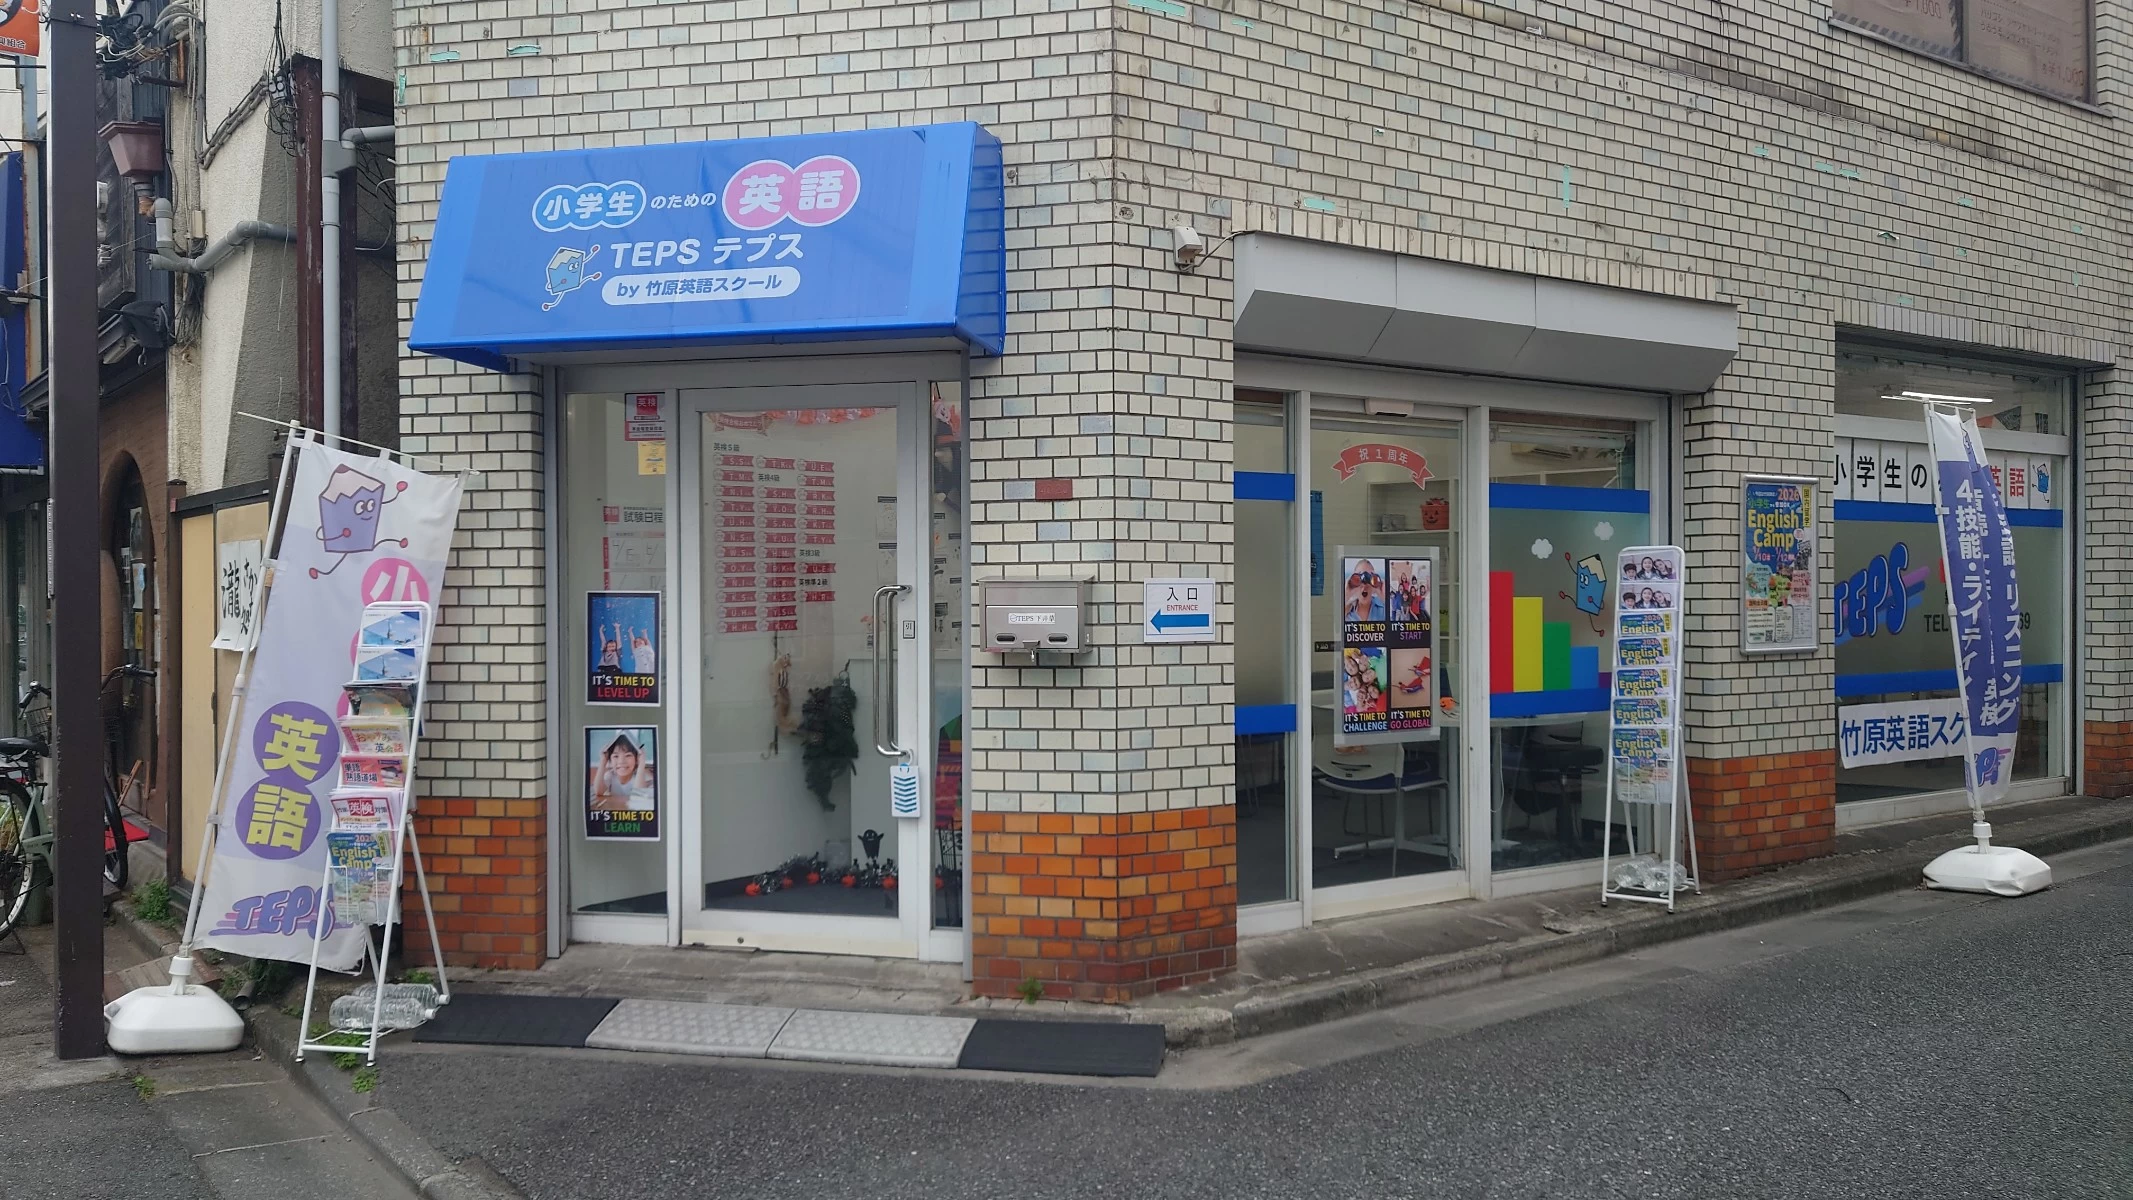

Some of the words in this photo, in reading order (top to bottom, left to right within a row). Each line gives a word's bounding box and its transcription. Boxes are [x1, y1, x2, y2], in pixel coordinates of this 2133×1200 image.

[543, 191, 637, 221] 小学生
[651, 193, 716, 209] のための
[738, 170, 844, 215] 英語
[611, 238, 700, 268] TEPS
[714, 233, 804, 263] テプス
[617, 283, 638, 298] by
[646, 275, 782, 297] 竹原英語スクール
[1778, 489, 1799, 500] 2026
[624, 512, 664, 523] 試験日程
[1748, 509, 1799, 533] English
[1754, 529, 1794, 551] Camp
[1167, 587, 1198, 601] 入口
[1835, 542, 1909, 638] TEPS
[1956, 479, 1982, 700] 4技能・ライティ
[1344, 623, 1358, 632] IT'S
[1359, 623, 1375, 632] TIME
[1376, 623, 1386, 632] TO
[1391, 622, 1405, 631] IT'S
[1405, 622, 1420, 631] TIME
[1421, 622, 1430, 631] TO
[1622, 623, 1661, 635] English
[1924, 614, 1948, 632] TEL
[1346, 633, 1385, 643] DISCOVER
[1400, 631, 1422, 640] START
[1621, 648, 1660, 660] English
[1626, 657, 1656, 665] Camp
[592, 675, 612, 686] IT'S
[614, 676, 638, 687] TIME
[641, 676, 655, 687] TO
[1619, 679, 1658, 691] English
[597, 687, 631, 698] LEVEL
[634, 688, 650, 699] UP
[1624, 689, 1655, 697] Camp
[1344, 712, 1358, 722] IT'S
[1359, 712, 1376, 721] TIME
[1377, 712, 1386, 721] TO
[1390, 710, 1404, 719] IT'S
[1405, 710, 1420, 719] TIME
[1421, 709, 1431, 718] TO
[1616, 708, 1658, 720] English
[1343, 721, 1388, 733] CHALLENGE
[1390, 720, 1401, 729] GO
[1403, 719, 1431, 728] GLOBAL
[1616, 738, 1658, 751] English
[1621, 748, 1653, 759] Camp
[245, 713, 328, 851] 英語
[590, 810, 611, 821] IT'S
[612, 811, 637, 821] TIME
[639, 811, 654, 821] TO
[604, 822, 641, 833] LEARN
[332, 847, 376, 858] English
[339, 857, 373, 870] Camp
